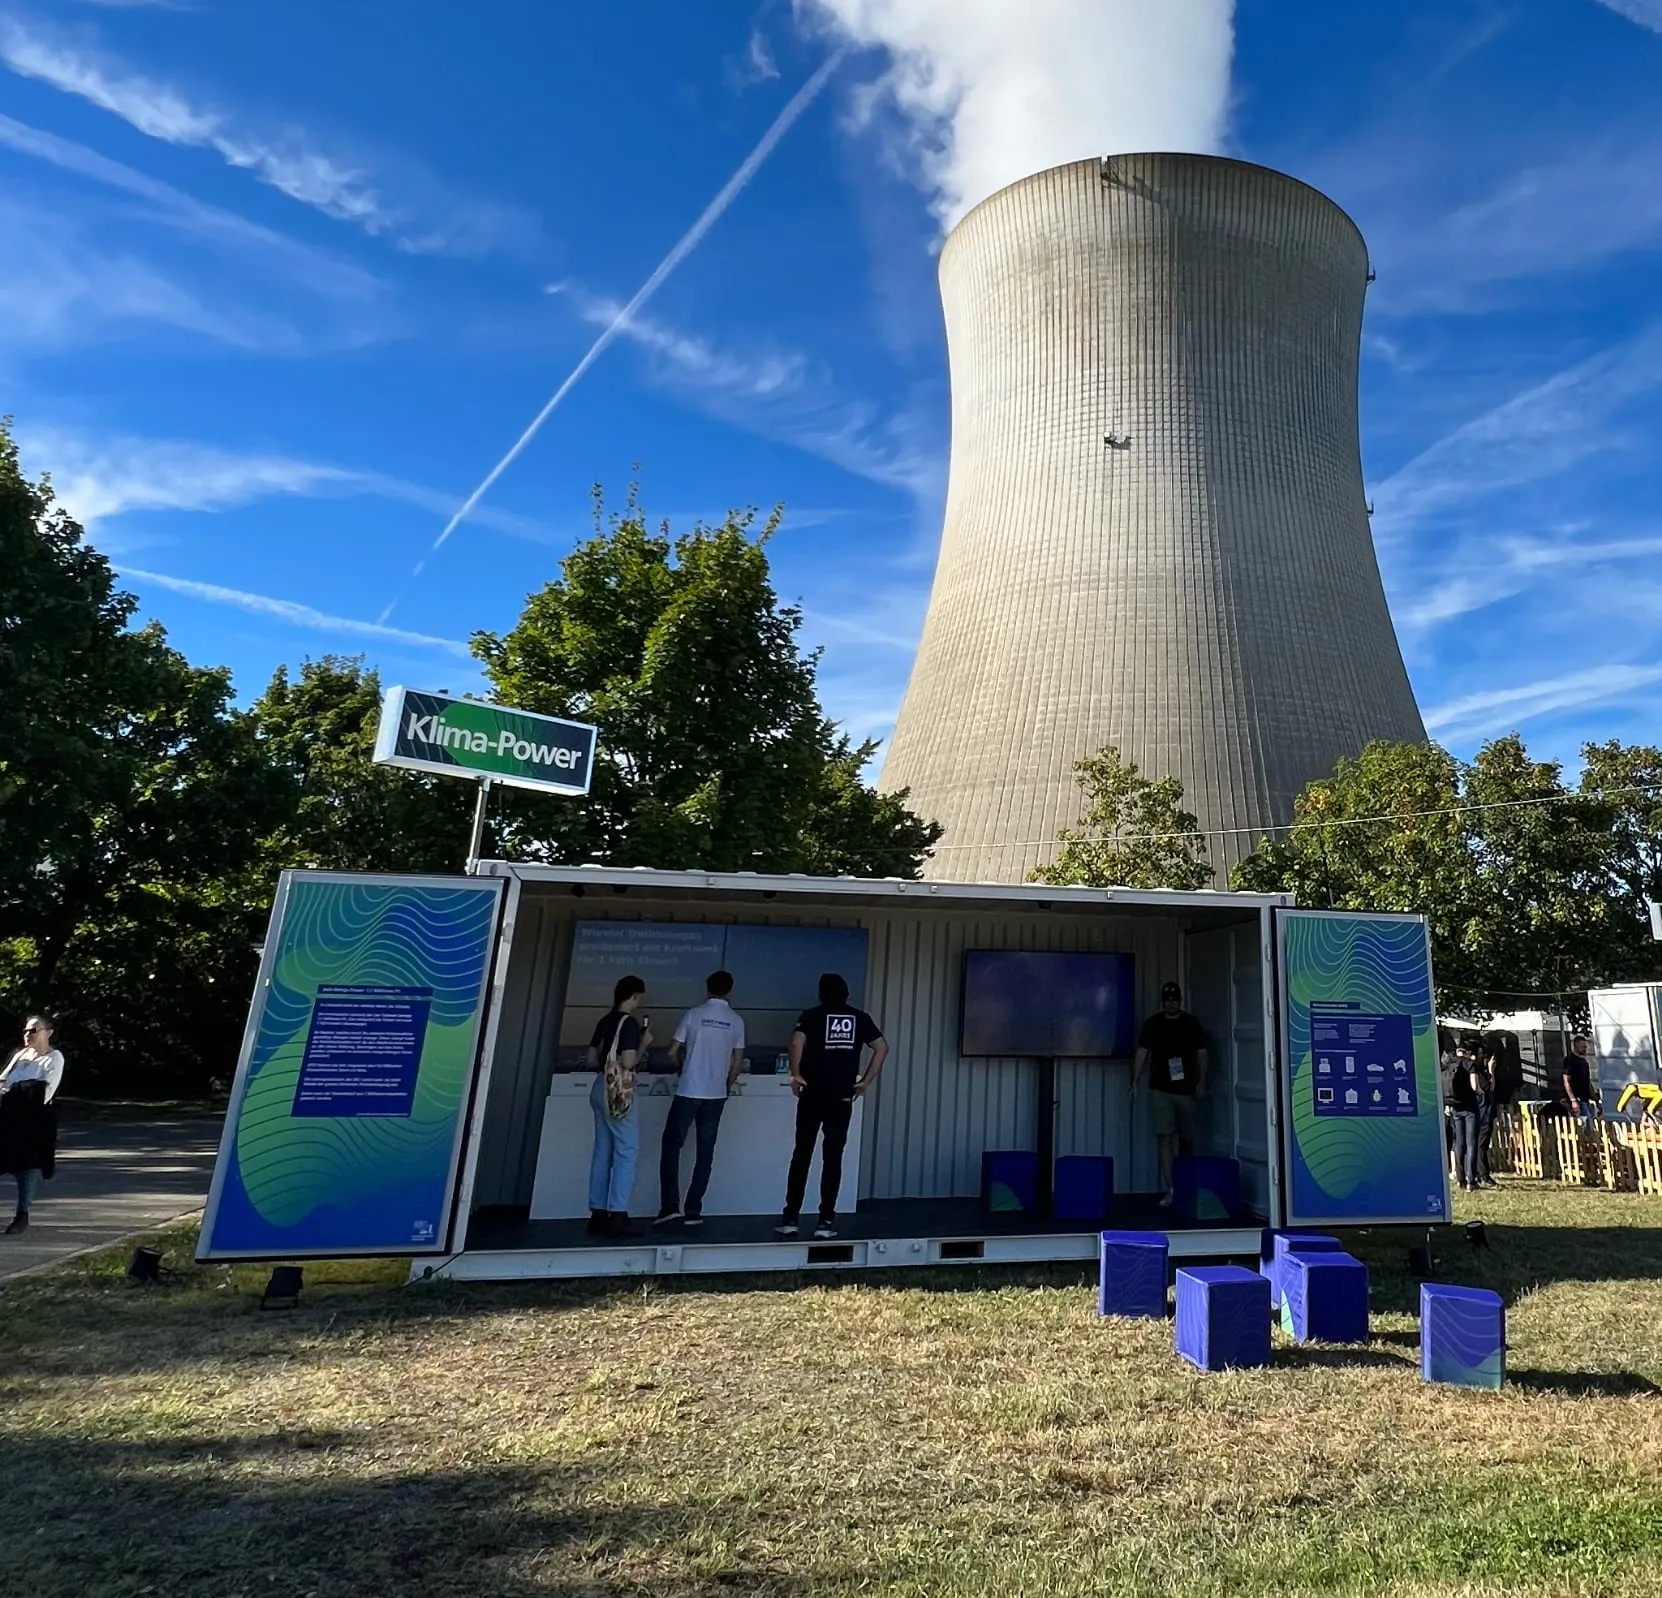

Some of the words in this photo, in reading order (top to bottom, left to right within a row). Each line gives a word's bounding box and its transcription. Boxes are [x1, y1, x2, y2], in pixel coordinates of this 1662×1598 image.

[407, 713, 582, 770] Klima-Power
[581, 928, 624, 937] Wieviel
[628, 929, 702, 941] Treibhausgas
[664, 943, 721, 953] Kraftwerk
[830, 1018, 852, 1032] 40
